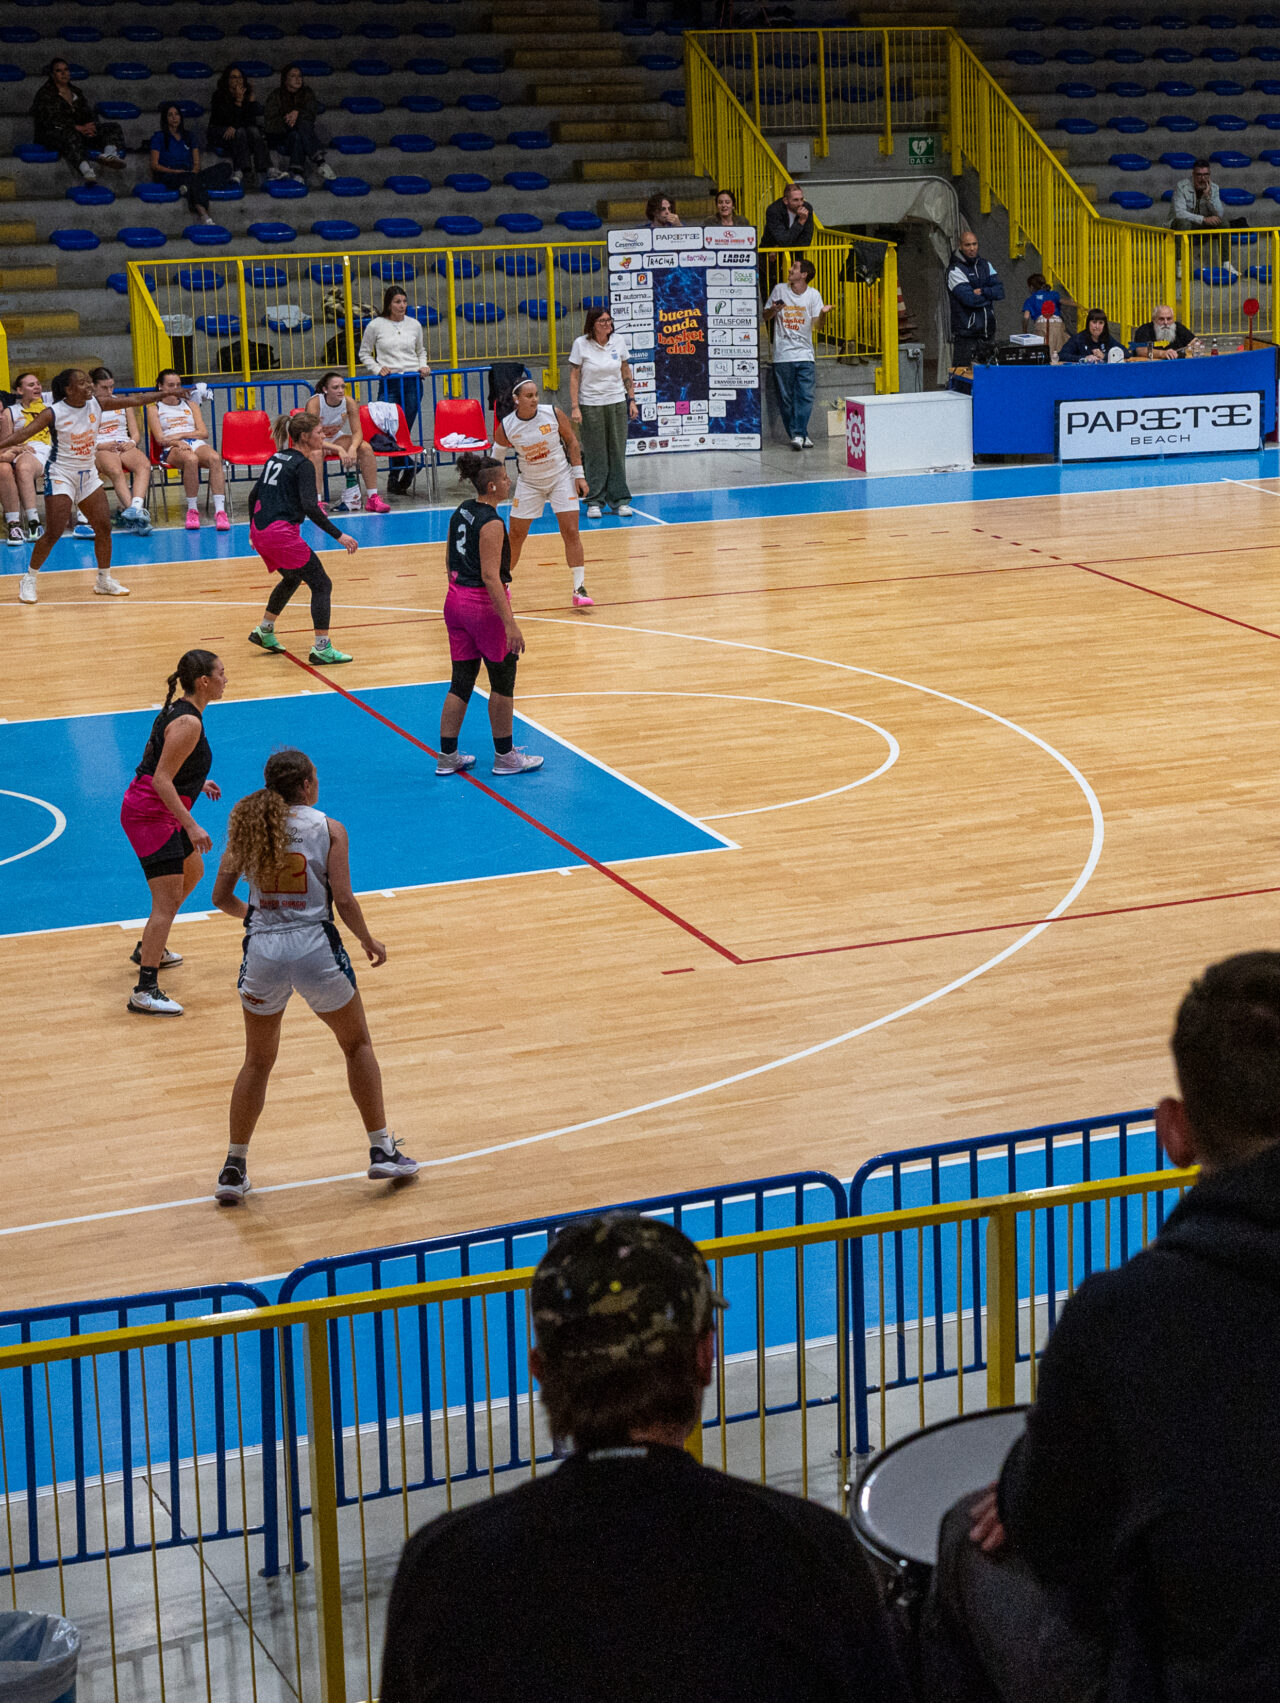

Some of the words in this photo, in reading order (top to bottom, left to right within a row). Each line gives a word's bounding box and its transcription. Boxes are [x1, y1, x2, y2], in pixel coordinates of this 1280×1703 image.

[658, 308, 702, 322] buena
[662, 317, 698, 334] onda
[657, 329, 704, 345] basket
[666, 340, 696, 355] club
[1131, 434, 1191, 445] BEACH
[263, 460, 283, 486] 12
[456, 523, 467, 556] 2
